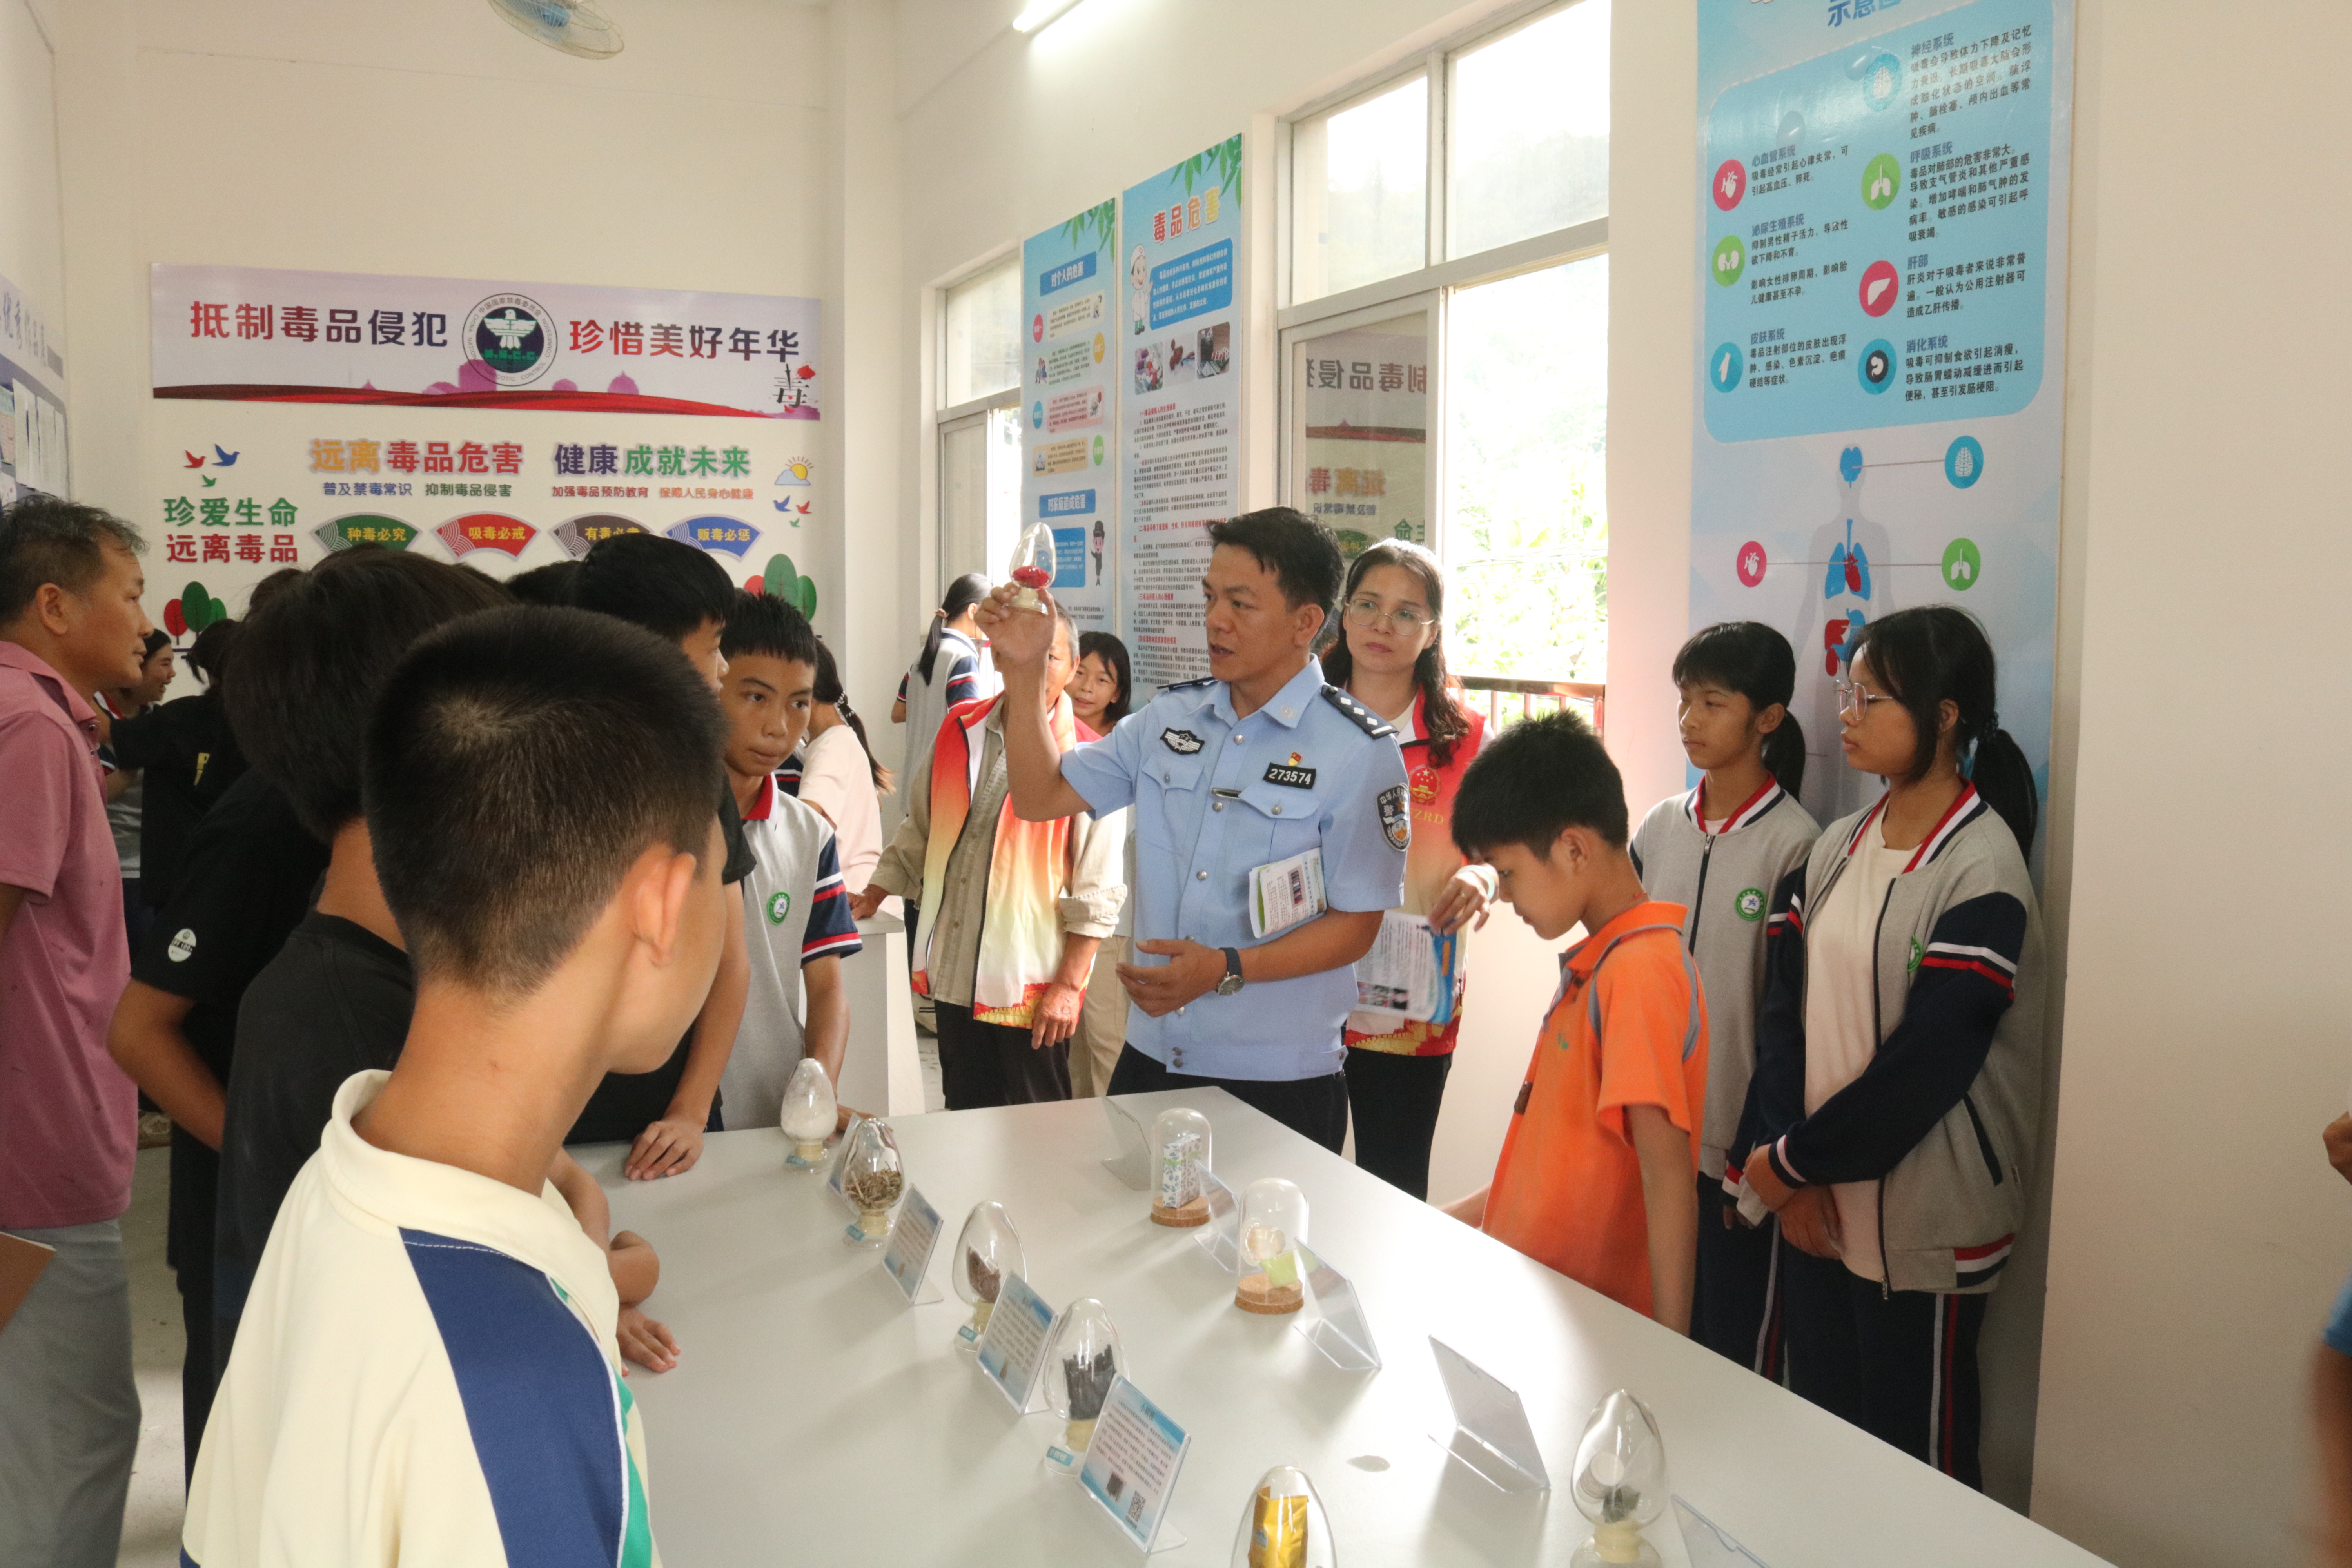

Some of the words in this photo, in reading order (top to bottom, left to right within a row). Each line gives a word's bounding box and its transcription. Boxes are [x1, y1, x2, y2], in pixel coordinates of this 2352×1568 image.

[1911, 32, 1954, 58] 神经系统
[1911, 25, 2032, 73] 吸毒会导致体力下降及记忆
[1910, 122, 1940, 140] 见疾病。
[1751, 144, 1796, 167] 心血管系统
[1910, 141, 1953, 163] 呼吸系统
[1910, 143, 2016, 179] 毒品对肺部的危害非常大。
[1752, 171, 1815, 196] 引起高血压、猝死。
[1910, 153, 2030, 193] 导致支气管炎和其他严重感
[1909, 171, 2029, 210] 染。增加哮喘和肺气肿的发
[1154, 188, 1220, 242] 毒品危害
[1909, 188, 2029, 226] 病率。敏感的感染可引起呼
[1751, 213, 1804, 237] 泌尿生殖系统
[1751, 219, 1848, 250] 抑制男性精子活力，导致性
[1751, 247, 1798, 265] 欲下降和不育。
[1907, 254, 1929, 270] 肝部
[1751, 261, 1847, 290] 影响女性排卵周期，影响胎
[1907, 252, 2026, 285] 肝炎对于吸毒者来说非常普
[1751, 285, 1805, 305] 儿健康甚至不孕。
[1907, 270, 2026, 301] 遍。一般认为公用注射器可
[479, 297, 542, 317] 中国国家禁毒委员会
[1906, 298, 1964, 318] 造成乙肝传播。
[190, 301, 448, 347] 抵制毒品侵犯
[468, 314, 479, 332] CHINA
[569, 319, 799, 362] 珍惜美好年华
[1750, 328, 1785, 345] 皮肤系统
[1750, 334, 1846, 358] 毒品注射部位的皮肤出现浮
[1906, 335, 1948, 353] 消化系统
[1749, 349, 1846, 373] 肿、感染、色素沉淀、疤痕
[1906, 343, 2018, 368] 吸毒可抑制食欲引起消瘦，
[521, 361, 546, 380] CONTROL
[1749, 374, 1789, 388] 硬结等症状。
[1905, 359, 2024, 385] 导致肠胃蠕动减缓进而引起
[1905, 381, 1999, 402] 便秘，甚至引发肠梗阻。
[312, 439, 523, 474] 远离毒品危害
[323, 482, 412, 497] 普及禁毒常识
[425, 483, 512, 497] 抑制毒品侵害
[552, 485, 649, 498] 加强毒品预防教育
[659, 487, 753, 500] 保障人民身心健康
[164, 496, 298, 527] 珍爱生命
[347, 527, 407, 542] 种毒必究
[468, 526, 526, 541] 吸毒必戒
[697, 527, 751, 542] 贩毒必惩
[166, 533, 298, 564] 远离毒品
[1268, 768, 1313, 785] 273574
